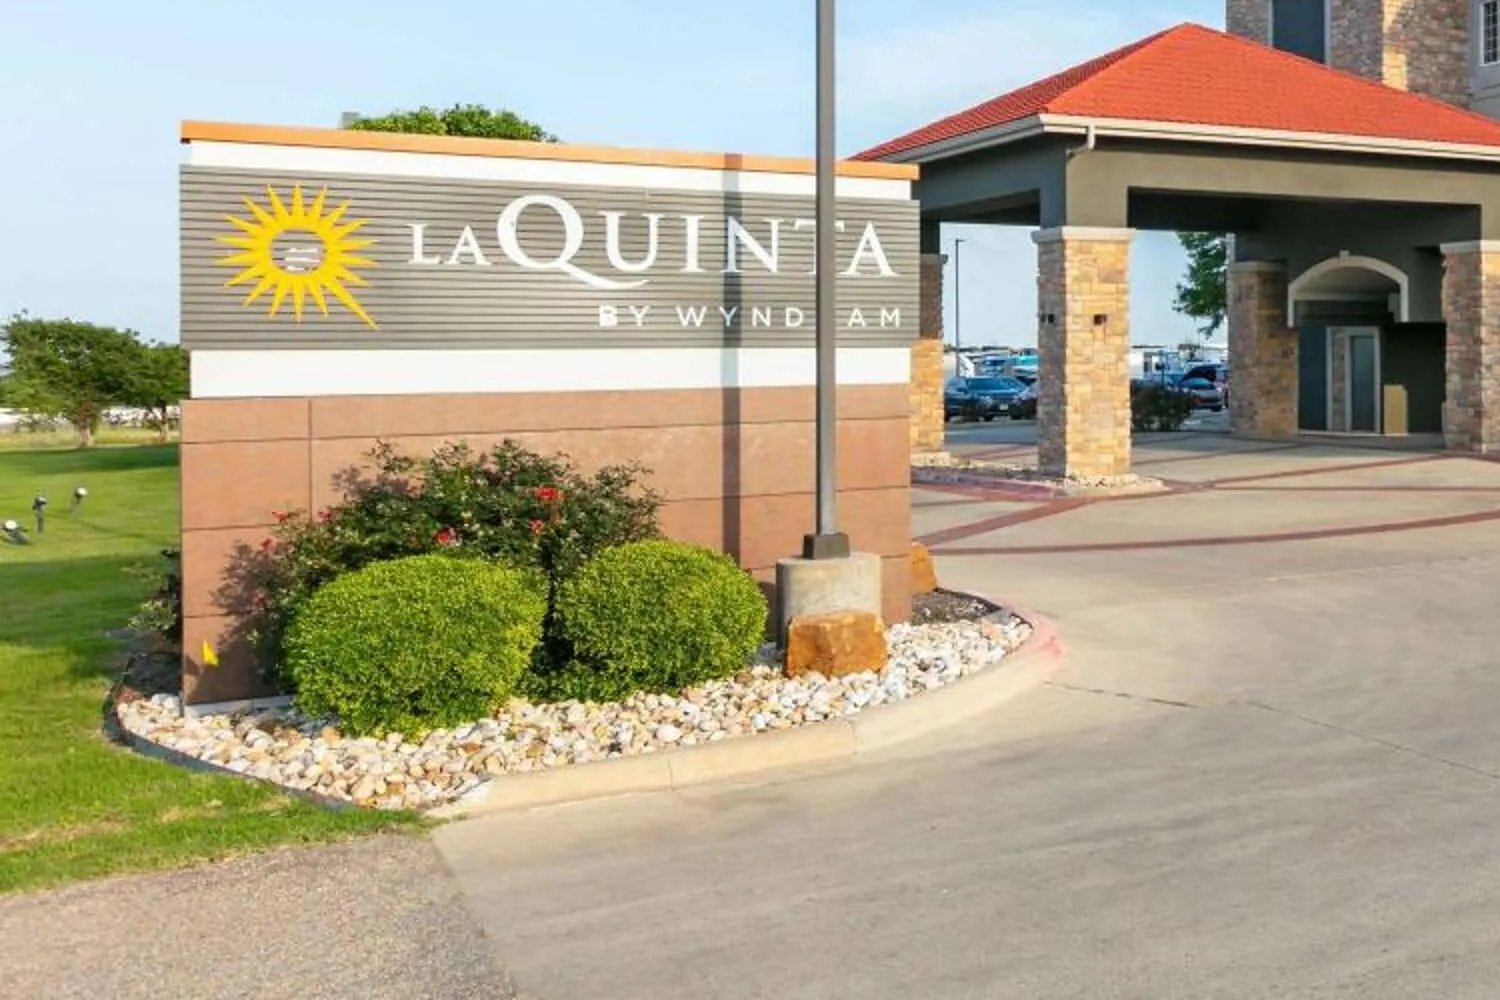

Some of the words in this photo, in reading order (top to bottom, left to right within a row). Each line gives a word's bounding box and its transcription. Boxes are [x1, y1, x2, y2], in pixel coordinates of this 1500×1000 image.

[407, 223, 491, 266] LA
[599, 304, 650, 328] BY
[676, 305, 901, 329] WYNDAM
